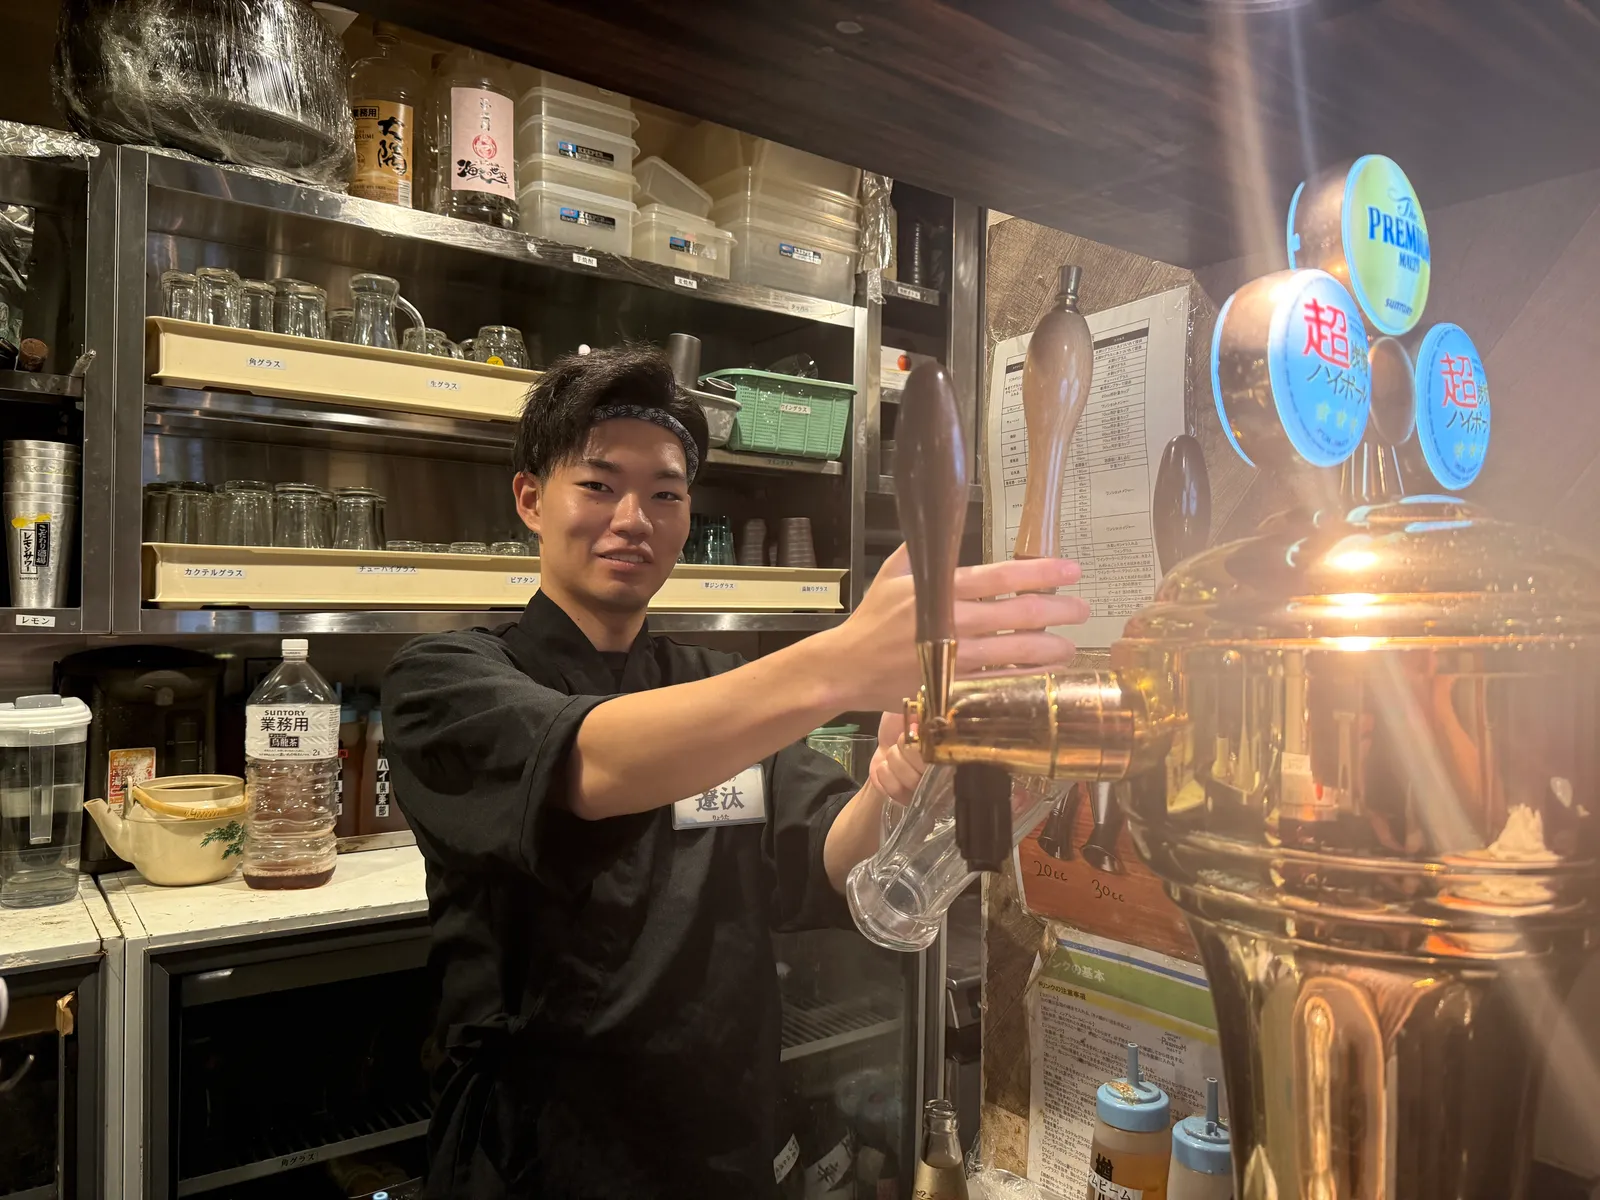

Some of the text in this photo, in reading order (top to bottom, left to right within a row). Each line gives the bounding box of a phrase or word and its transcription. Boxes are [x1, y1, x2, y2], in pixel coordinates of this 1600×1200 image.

[1302, 297, 1350, 370] 超
[249, 357, 280, 368] 角グラス
[430, 380, 458, 390] 生グラス
[1439, 351, 1478, 409] 超
[23, 531, 34, 572] レモンサワー
[184, 567, 243, 577] カクテルグラス
[22, 616, 50, 625] レモン
[264, 709, 307, 717] SUNTORY
[260, 716, 309, 733] 業務用
[1033, 860, 1068, 881] 20cc
[1091, 879, 1125, 902] 30cc
[1038, 980, 1087, 1001] ドリンクの注意事項
[280, 1152, 316, 1167] 角グラス
